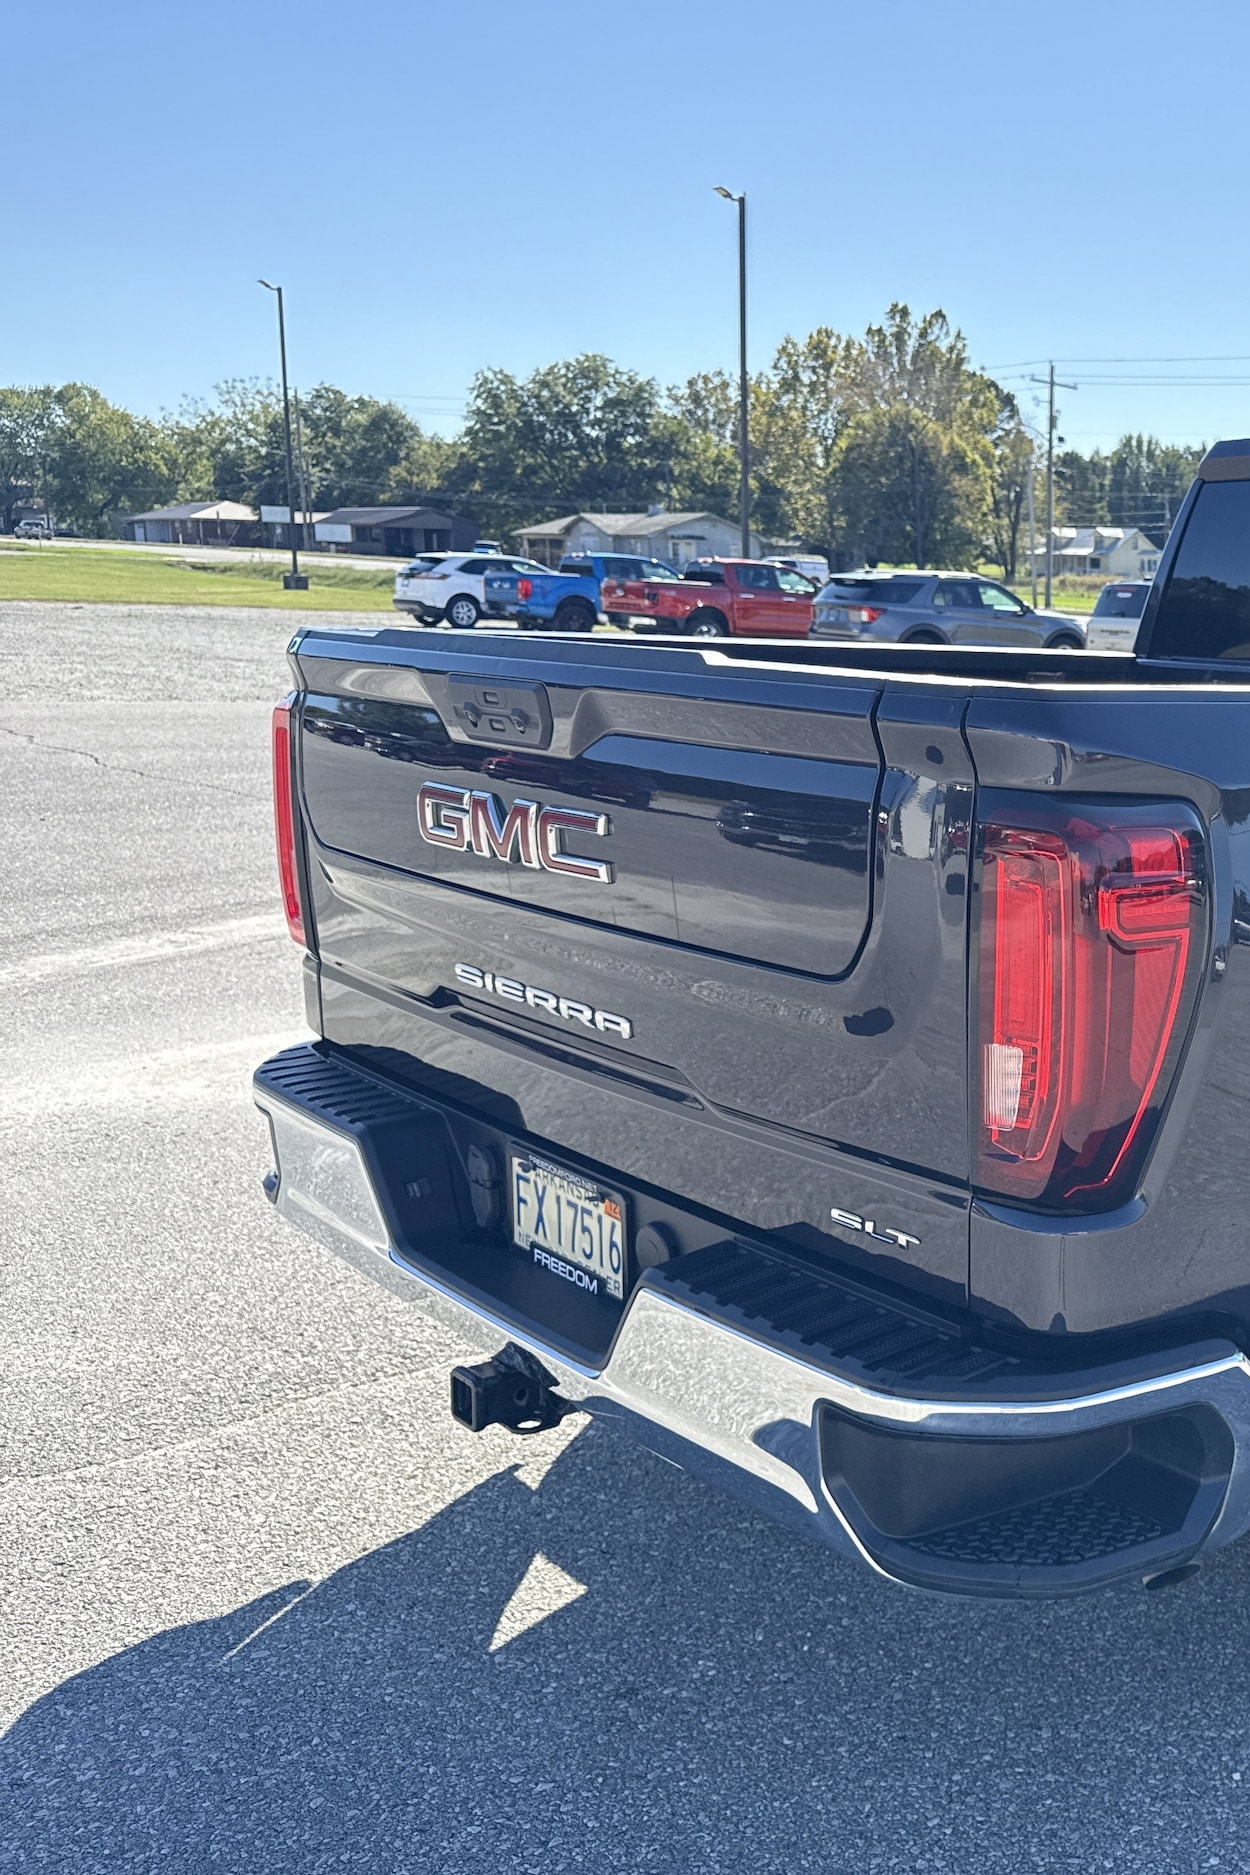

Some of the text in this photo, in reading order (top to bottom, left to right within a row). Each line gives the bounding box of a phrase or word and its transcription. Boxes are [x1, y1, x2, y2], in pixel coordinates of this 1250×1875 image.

[416, 780, 617, 884] GMC
[454, 961, 634, 1040] SIERRA
[528, 1154, 598, 1191] FREEDOMFORD.NET
[515, 1172, 621, 1275] FX17516
[830, 1207, 921, 1247] SLT
[533, 1248, 598, 1295] FREEDOM
